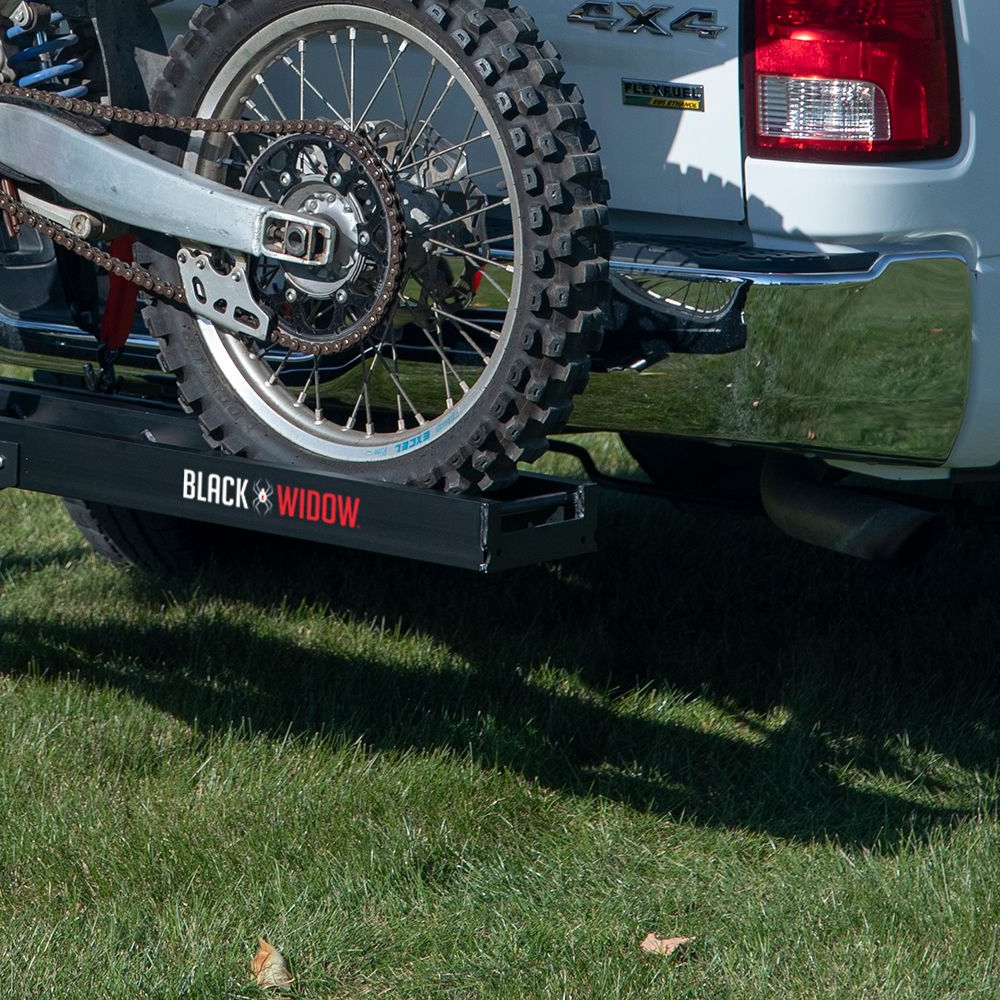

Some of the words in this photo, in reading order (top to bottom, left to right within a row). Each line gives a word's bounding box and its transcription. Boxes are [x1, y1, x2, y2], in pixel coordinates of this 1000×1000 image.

[566, 0, 729, 41] 4X4
[182, 468, 249, 510] BLACK
[276, 483, 361, 529] WIDOW
